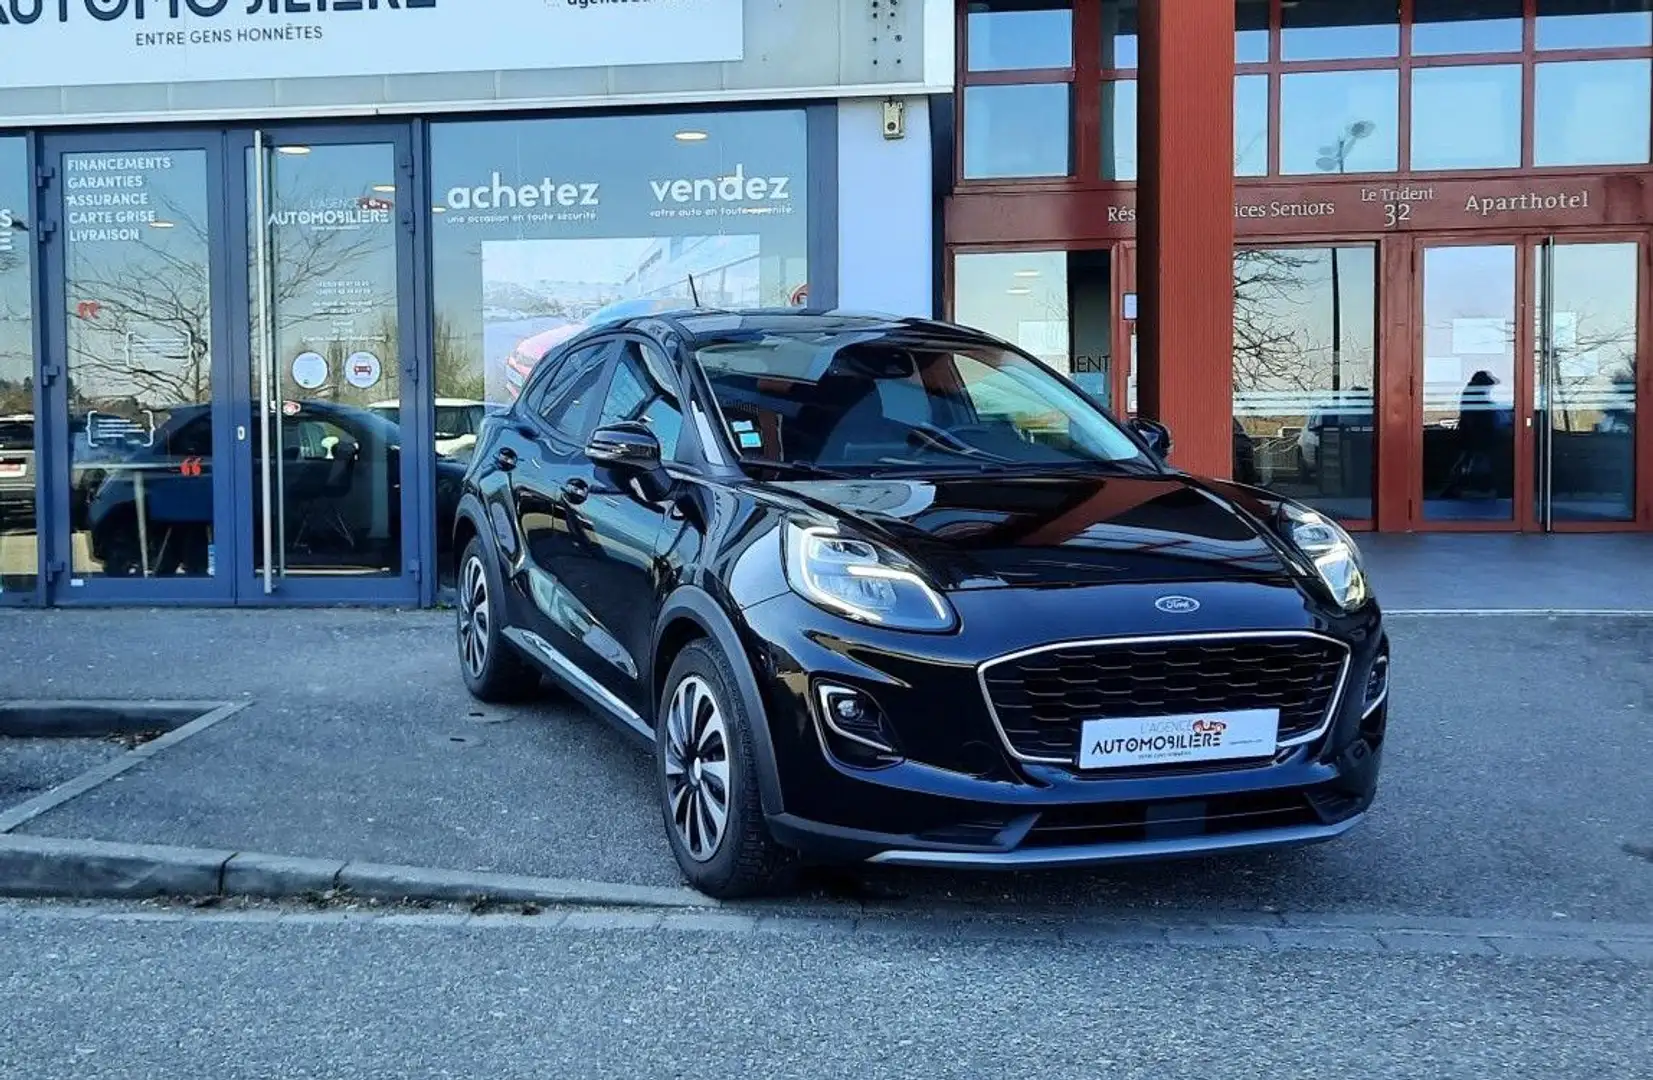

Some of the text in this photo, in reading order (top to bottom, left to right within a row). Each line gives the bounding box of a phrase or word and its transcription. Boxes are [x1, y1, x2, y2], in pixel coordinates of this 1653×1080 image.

[135, 22, 324, 47] ENTRE GENS HONNÊTES
[67, 156, 172, 171] FINANCEMENTS
[67, 175, 143, 189] GARANTIES
[447, 171, 600, 209] achetez
[649, 162, 790, 203] vendez
[66, 192, 149, 206] ASSURANCE
[1360, 187, 1433, 202] Le Trident
[1270, 199, 1335, 218] Seniors
[1464, 190, 1589, 217] Aparthotel
[69, 209, 155, 224] CARTE GRISE
[1383, 203, 1411, 227] 32
[69, 227, 140, 242] LIVRAISON
